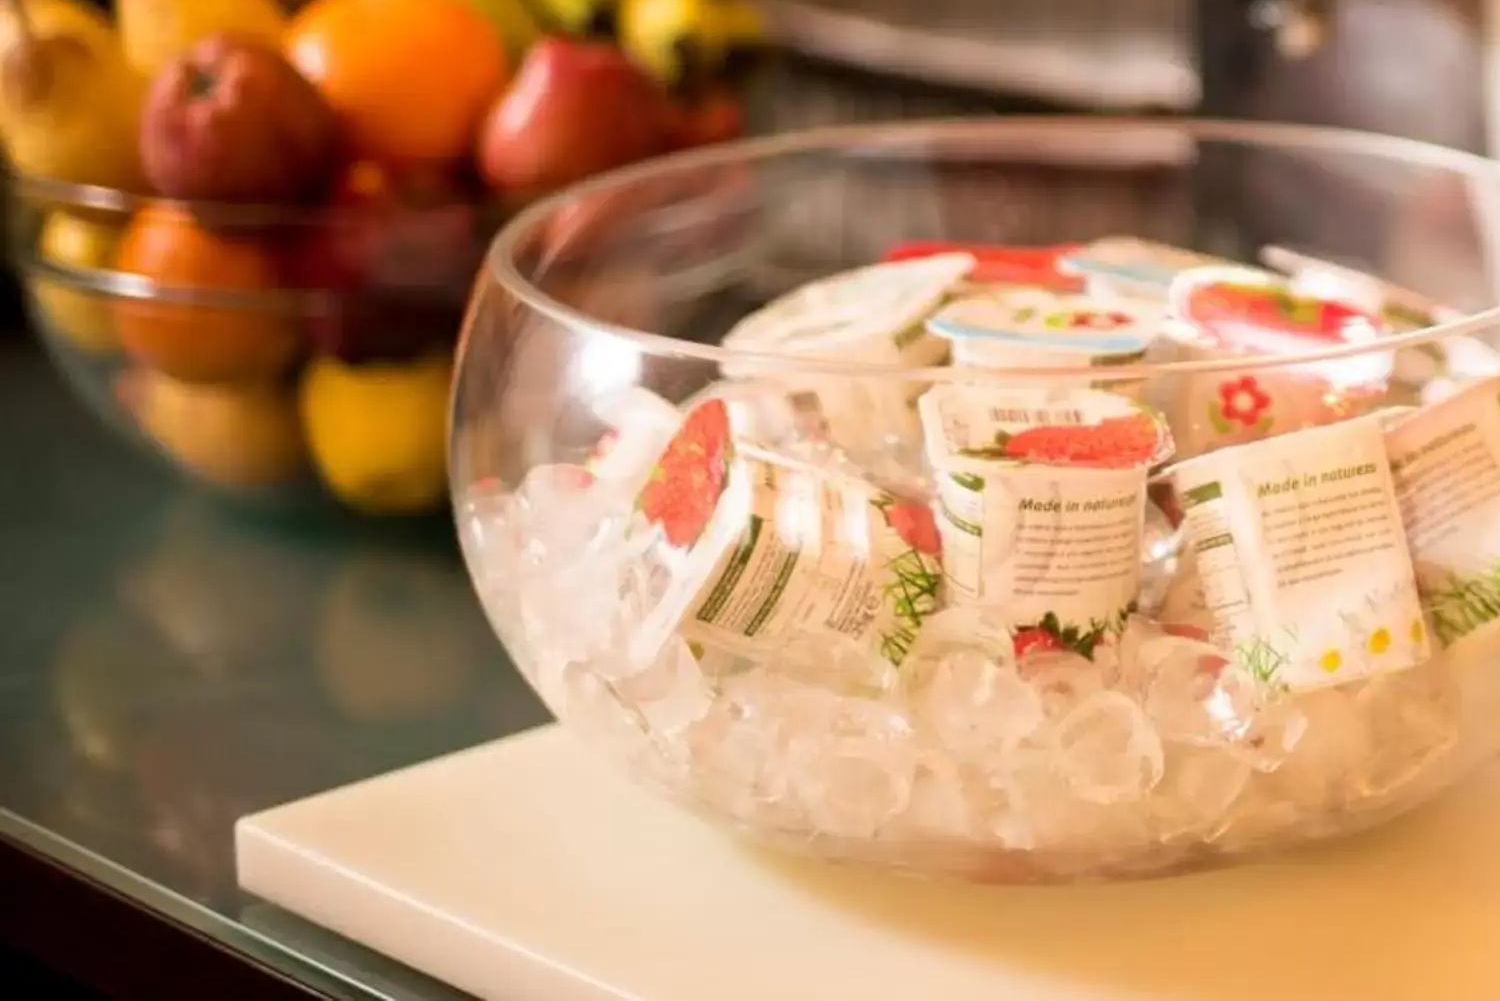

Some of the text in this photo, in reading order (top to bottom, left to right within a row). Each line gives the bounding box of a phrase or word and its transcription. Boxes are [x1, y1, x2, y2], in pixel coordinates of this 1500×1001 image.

[1257, 477, 1299, 498] Made
[1303, 471, 1317, 488] in
[1018, 498, 1061, 512] Made
[1065, 500, 1080, 512] in
